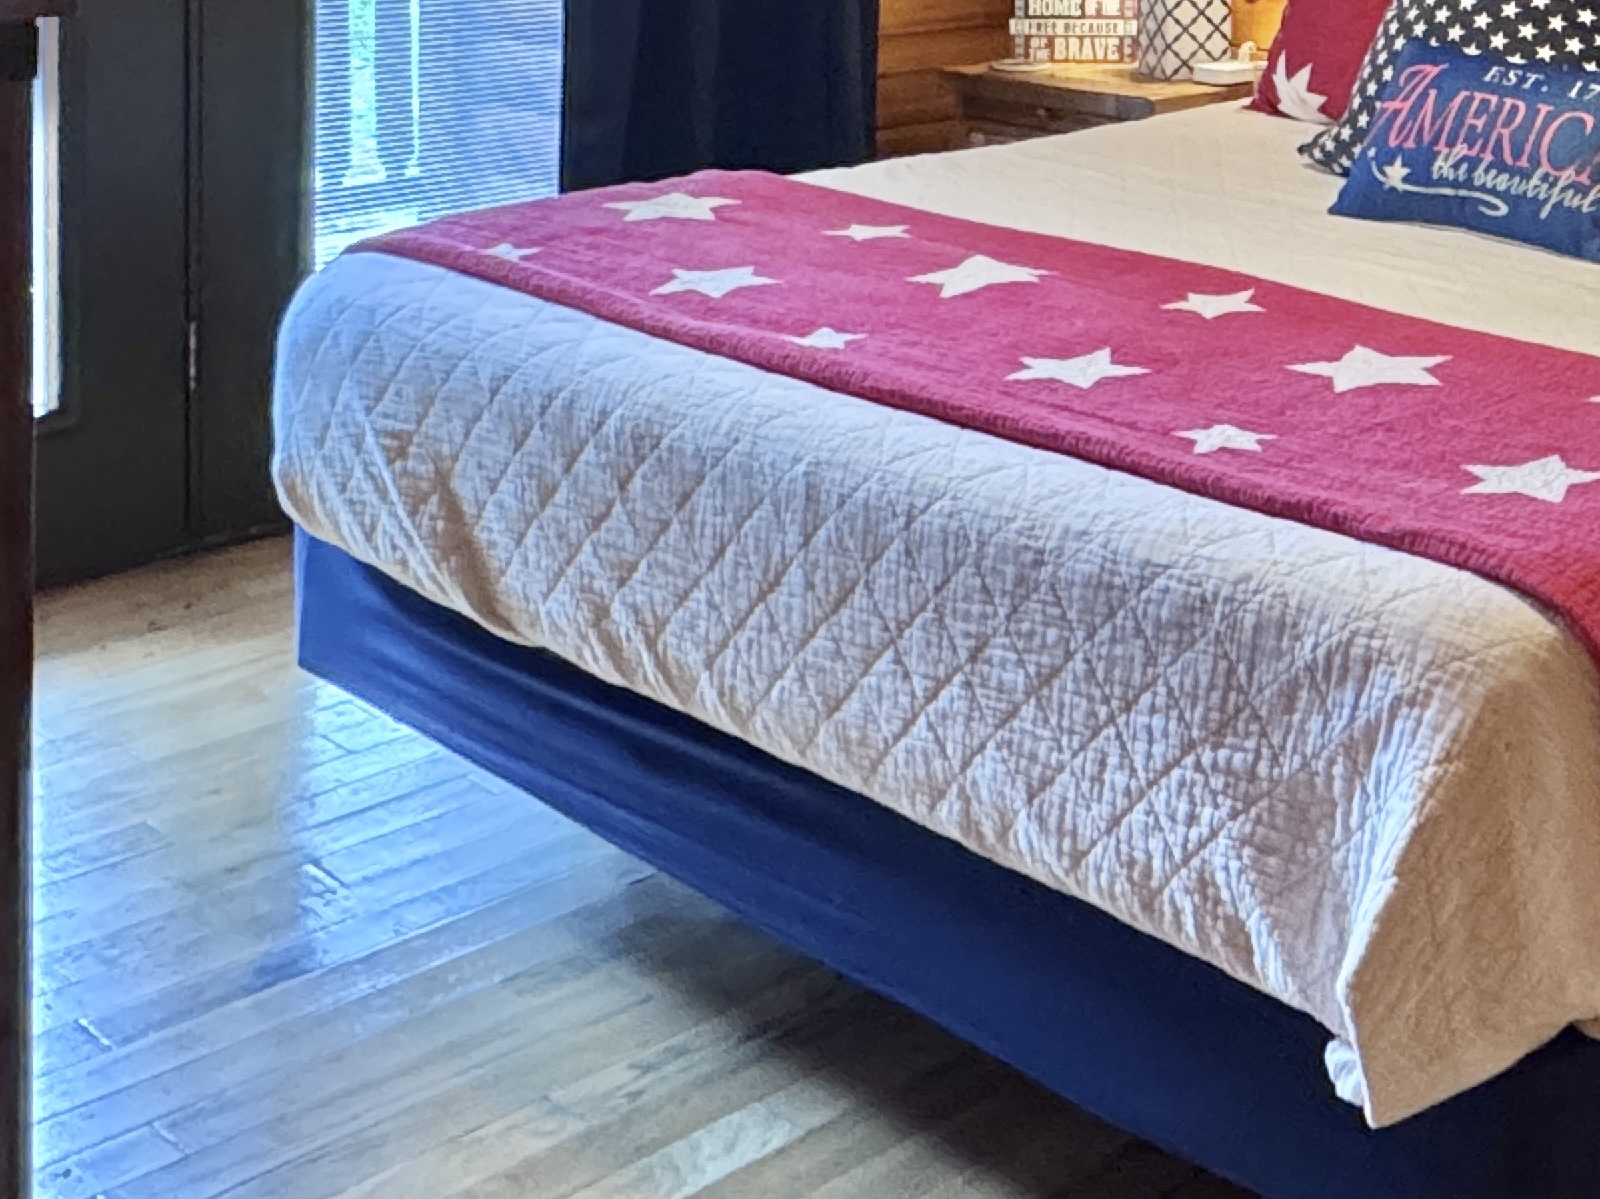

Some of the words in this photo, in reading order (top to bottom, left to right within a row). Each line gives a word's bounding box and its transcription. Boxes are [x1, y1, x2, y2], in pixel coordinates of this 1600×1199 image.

[1064, 22, 1118, 34] BECAUSE
[1054, 36, 1120, 60] BRAVE
[1482, 65, 1549, 93] EST.
[1430, 142, 1469, 181] the
